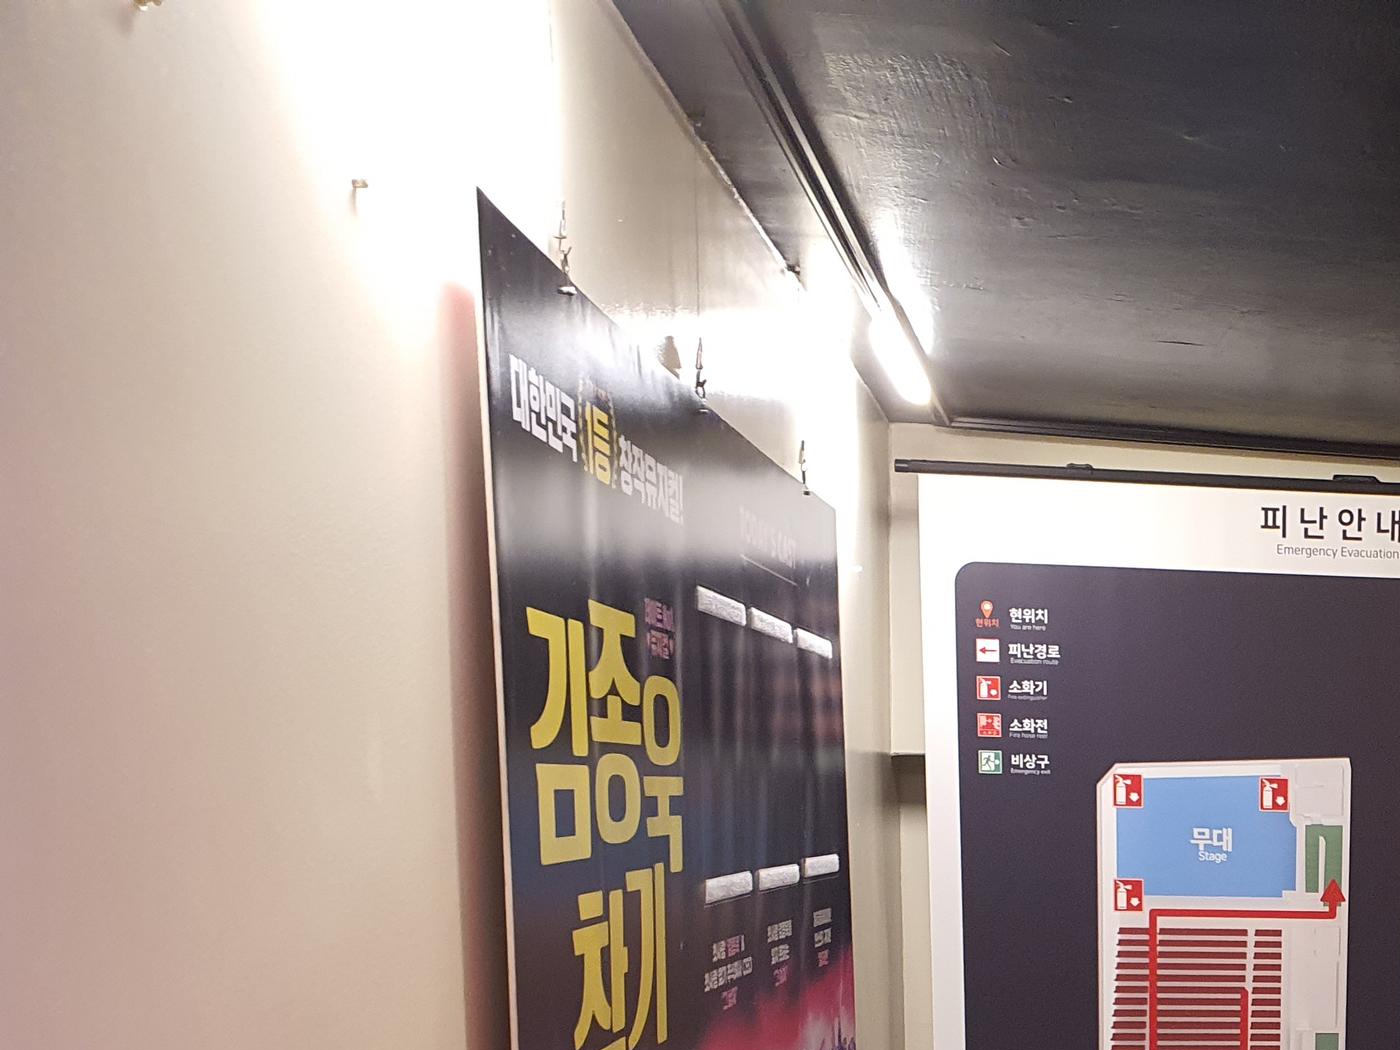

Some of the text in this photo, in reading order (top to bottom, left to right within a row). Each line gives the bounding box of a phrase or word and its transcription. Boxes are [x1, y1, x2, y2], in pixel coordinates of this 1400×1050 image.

[509, 354, 578, 462] 대한민국
[1276, 543, 1338, 560] Emergency
[1340, 546, 1400, 560] Evacuation
[1008, 607, 1049, 625] 현위치
[1008, 643, 1061, 660] 피난경로
[1008, 679, 1048, 696] 소화기
[1009, 718, 1048, 734] 소화전
[526, 598, 685, 873] 김종욱
[1011, 753, 1050, 769] 비상구
[1190, 827, 1233, 852] 무대
[1198, 851, 1228, 863] Stage
